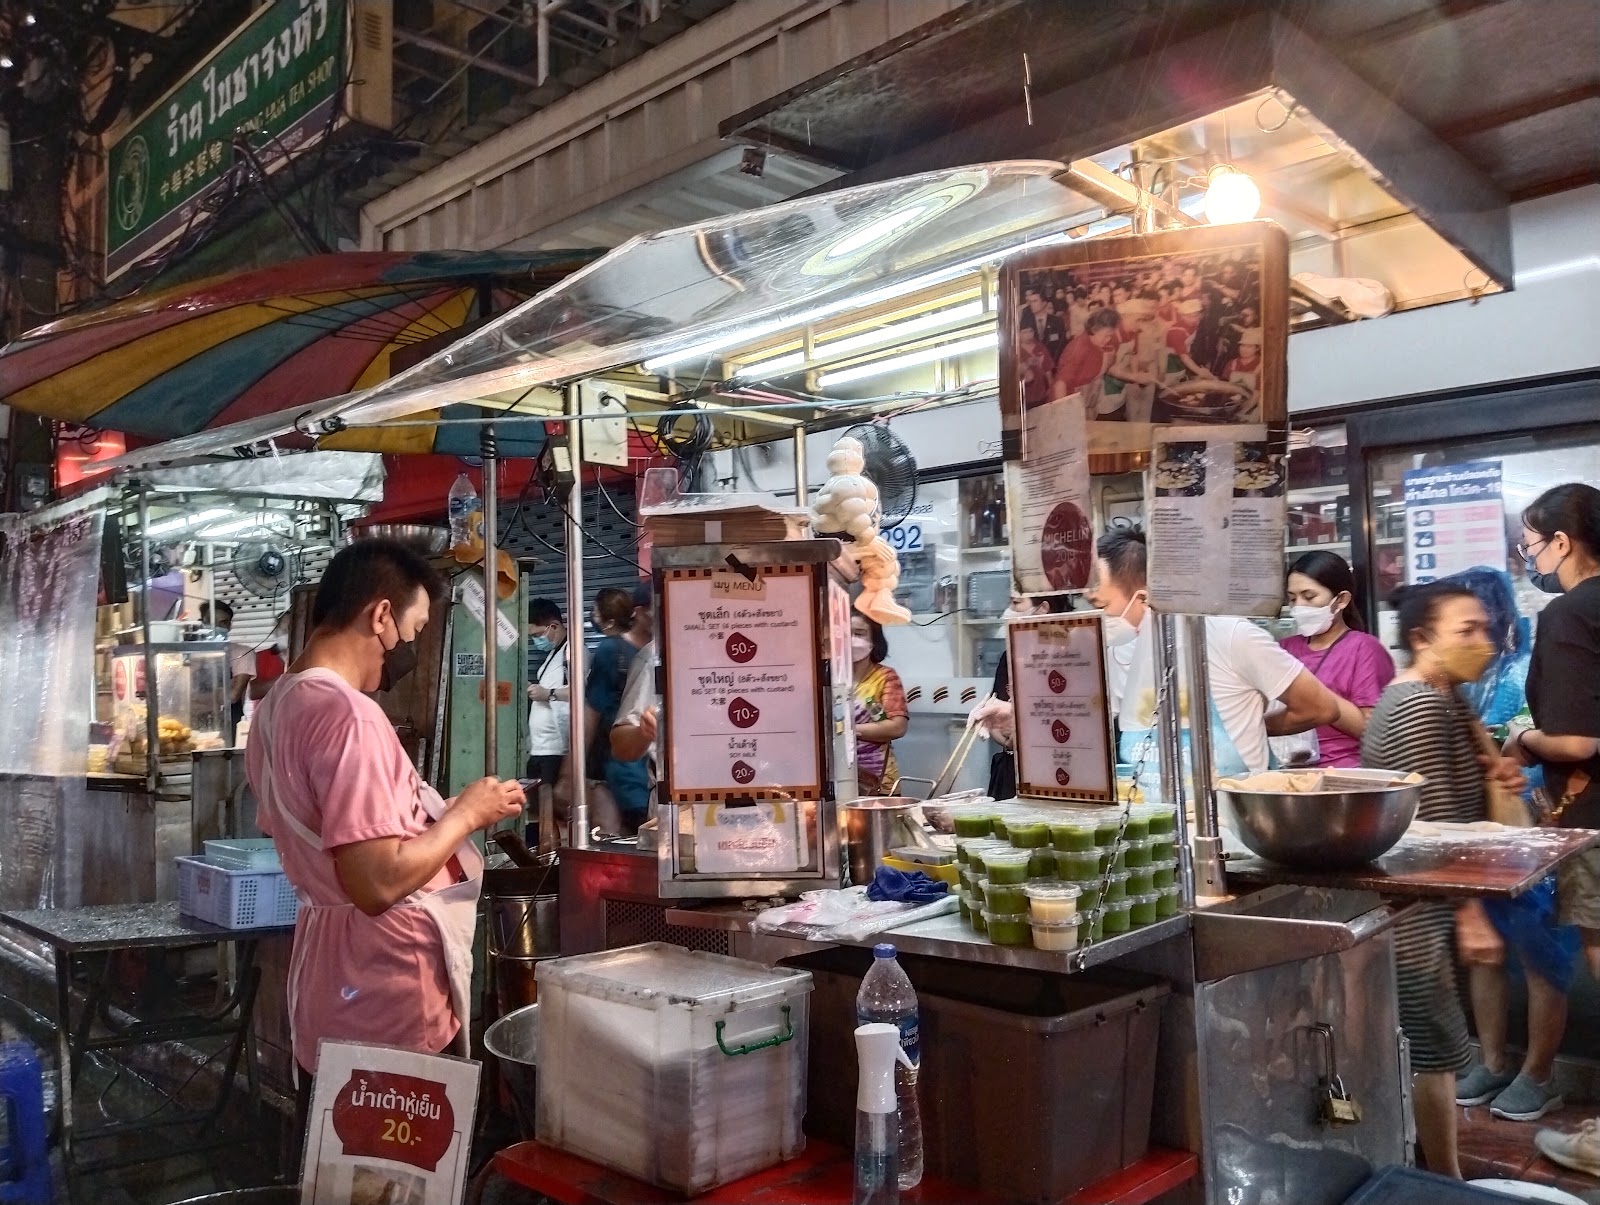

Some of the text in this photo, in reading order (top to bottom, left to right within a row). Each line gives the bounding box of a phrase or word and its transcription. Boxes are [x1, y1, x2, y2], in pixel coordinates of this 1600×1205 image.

[289, 80, 305, 107] TEA
[307, 56, 335, 93] SHOP
[167, 101, 203, 157] ร้าน
[1044, 527, 1089, 544] MICHELIN
[713, 581, 762, 593] เมนู MENU
[698, 606, 730, 623] ชุดเล็ก
[684, 623, 706, 631] SMALL
[731, 622, 753, 630] pieces
[753, 621, 769, 629] with
[731, 642, 756, 656] 50.-
[697, 671, 735, 688] ชุดใหญ่
[691, 688, 702, 696] BIG
[727, 687, 749, 695] pieces
[733, 707, 759, 722] 70.-
[728, 736, 758, 752] น้ำเต้าหู้
[735, 767, 753, 779] 20.-
[351, 1078, 441, 1121] น้ำเต้าหู้เย็น
[381, 1118, 422, 1146] 20.-
